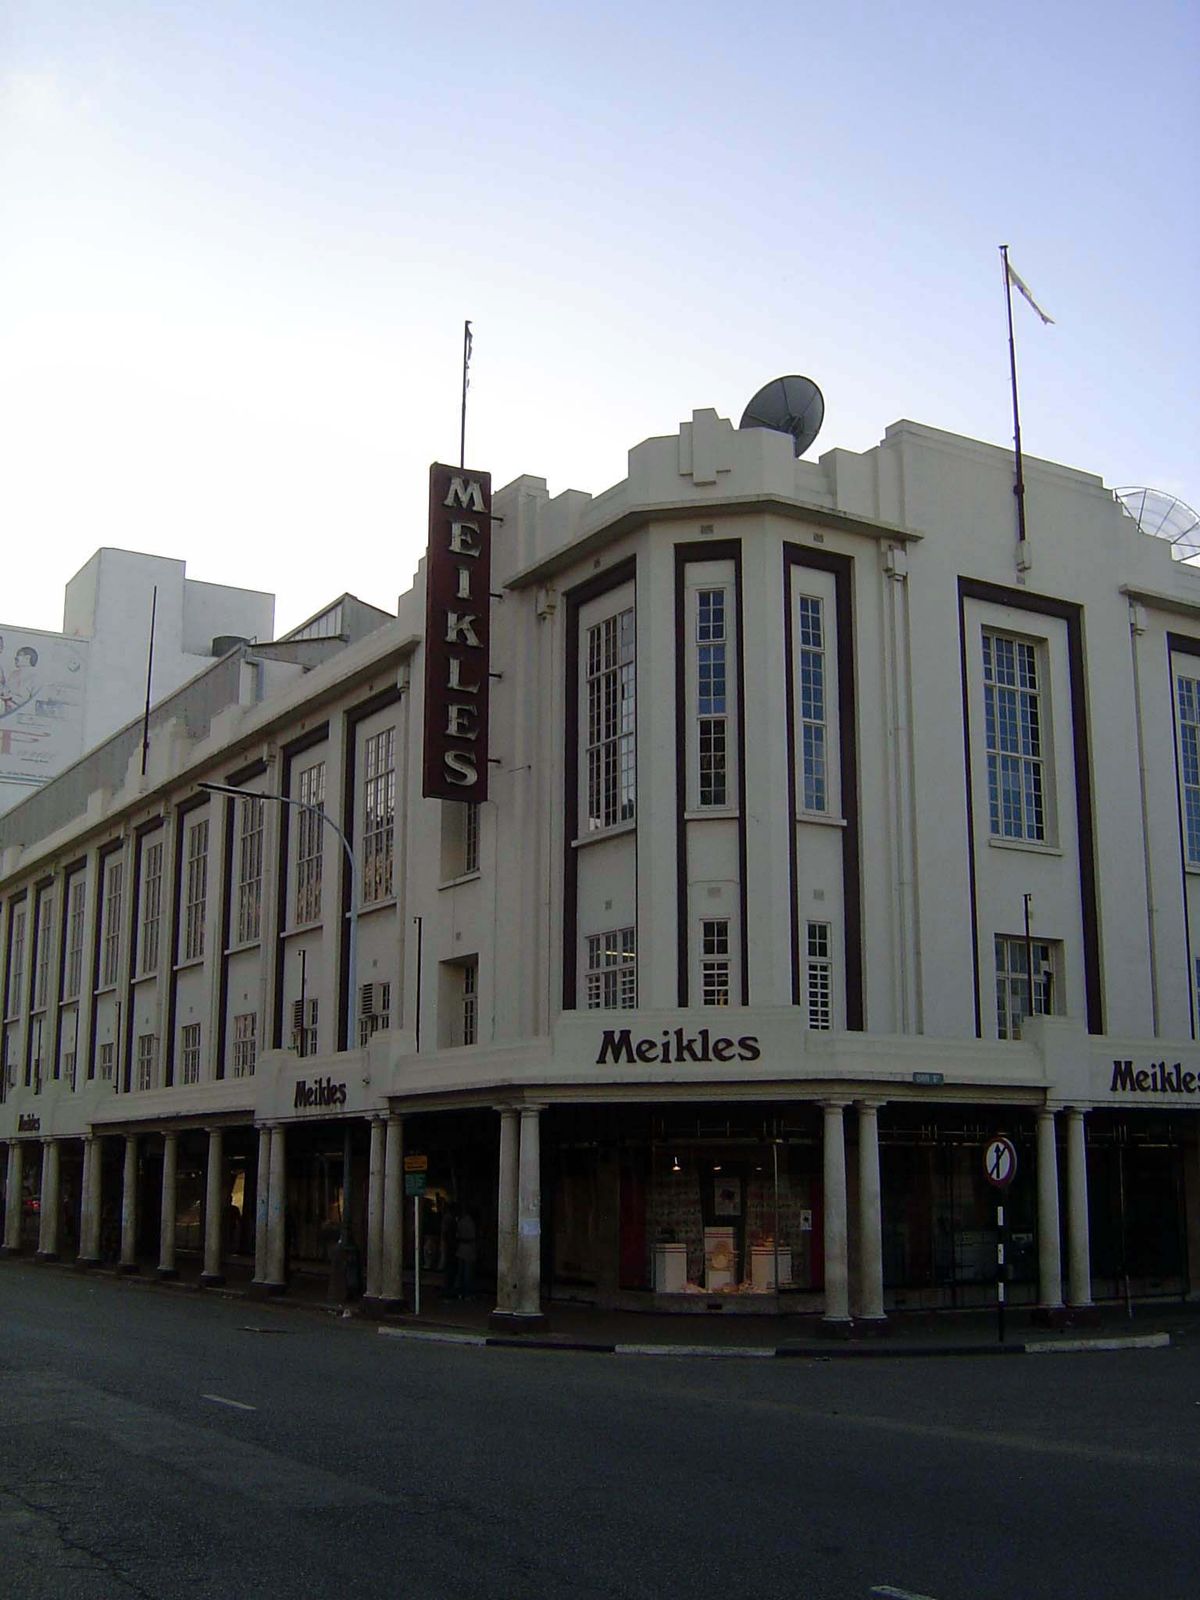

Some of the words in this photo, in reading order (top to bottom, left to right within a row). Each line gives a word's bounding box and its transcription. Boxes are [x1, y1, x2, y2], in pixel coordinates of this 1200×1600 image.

[443, 476, 487, 787] MEIKLES
[596, 1028, 761, 1064] Meikles
[294, 1076, 347, 1109] Meikles
[1110, 1061, 1200, 1093] Meikle
